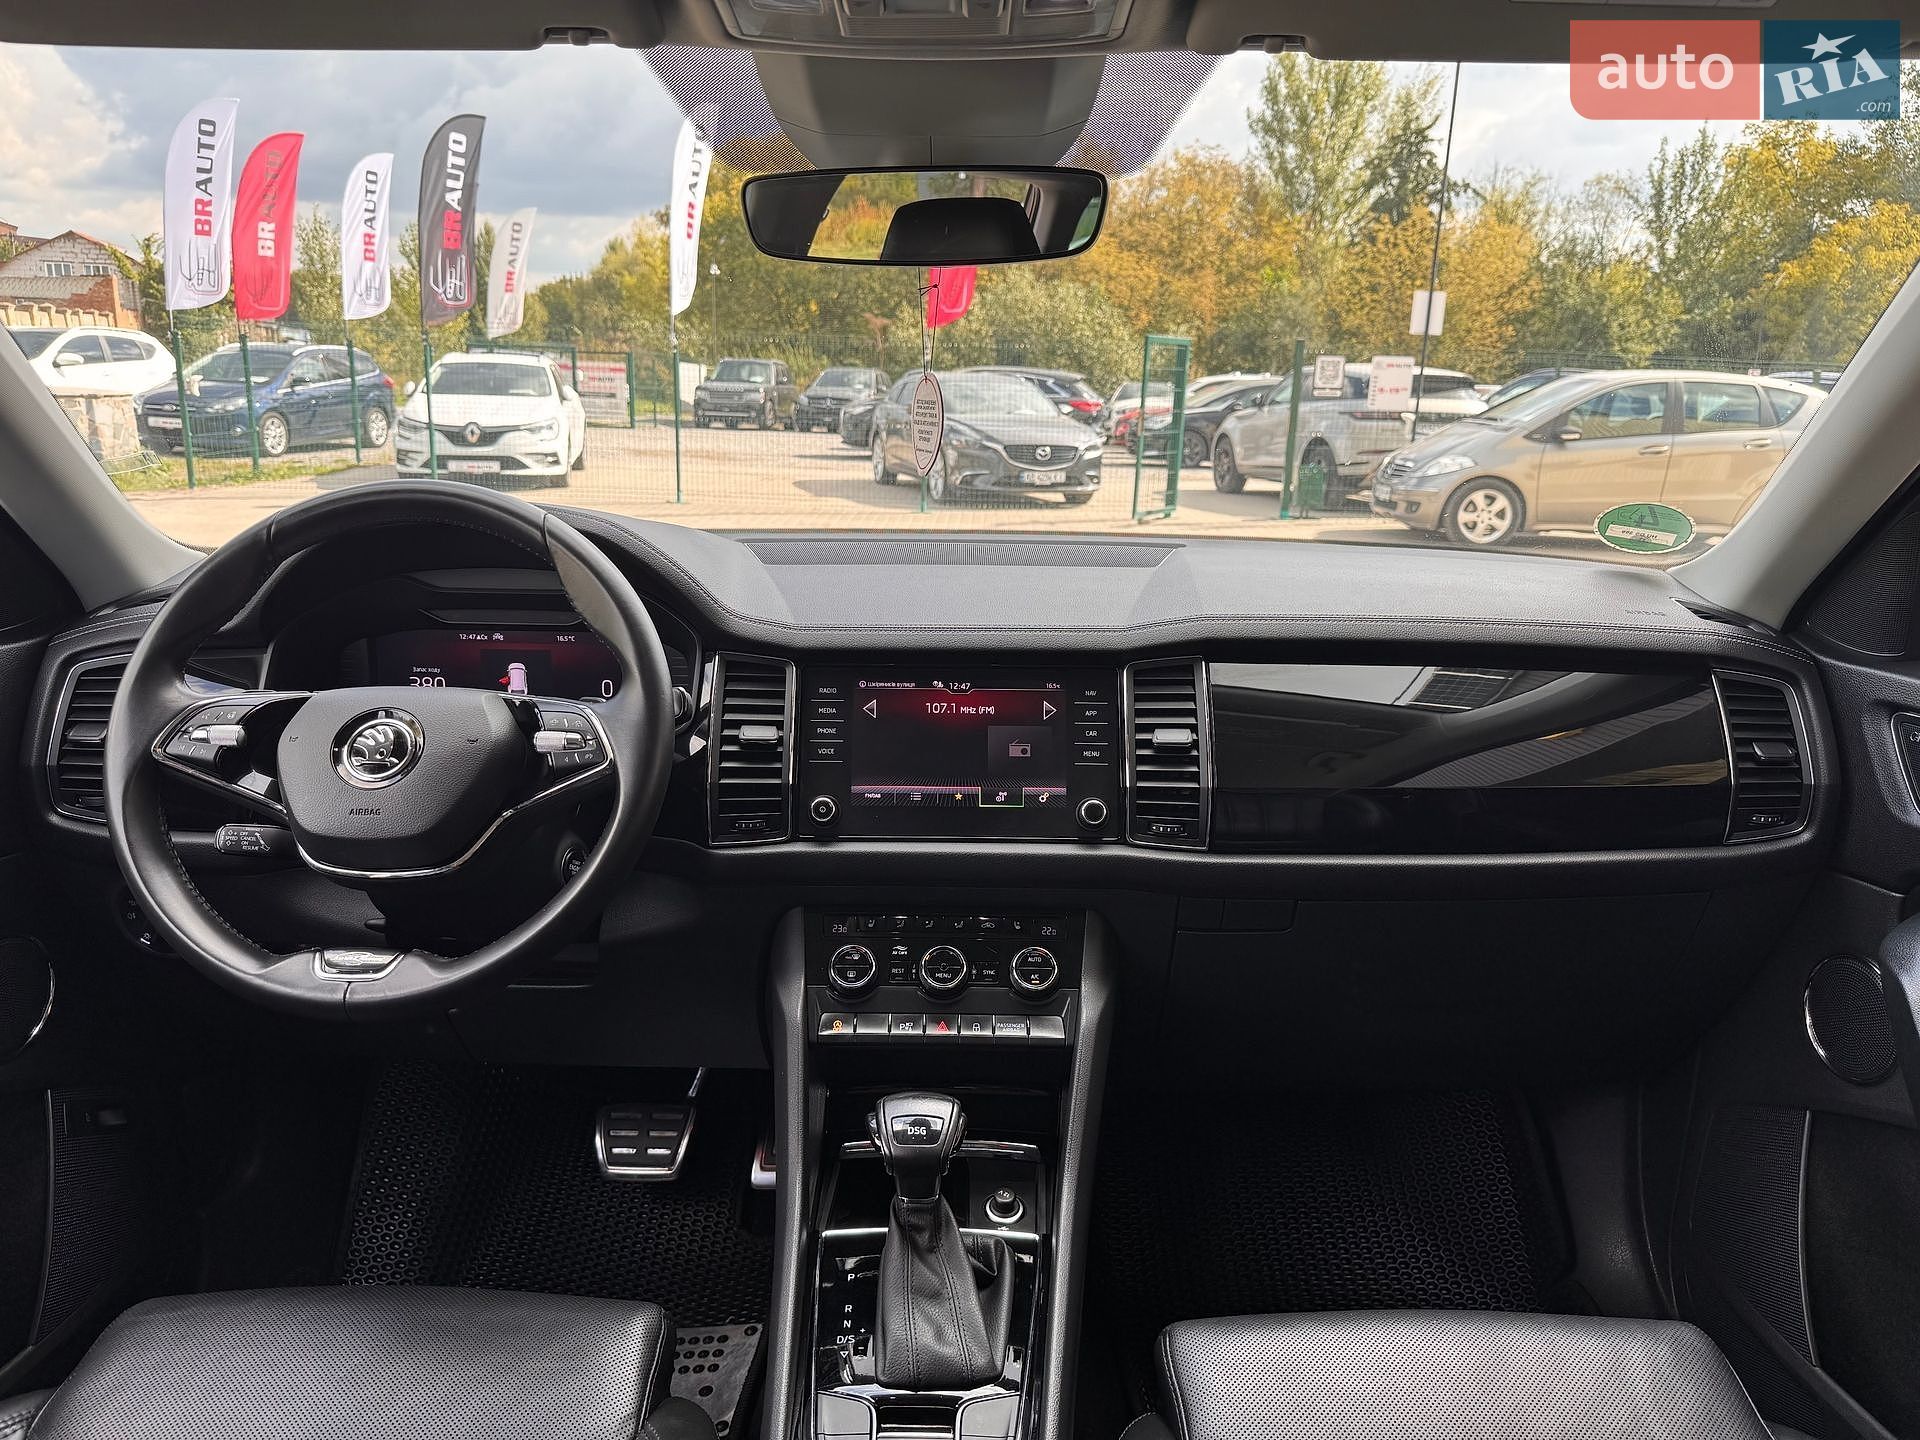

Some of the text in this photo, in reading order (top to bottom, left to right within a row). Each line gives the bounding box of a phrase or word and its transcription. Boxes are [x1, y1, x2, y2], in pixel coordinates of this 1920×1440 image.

[194, 118, 217, 237] BRAUTO
[442, 131, 468, 250] BRAUTO
[363, 170, 379, 263] BRAUTO
[504, 221, 523, 293] BRAUTO
[601, 679, 613, 698] 0
[949, 682, 971, 690] 12:47
[925, 702, 995, 715] 107.1 MHz (FM)
[349, 808, 381, 816] AIRBAG
[907, 1126, 927, 1135] DSG
[847, 1273, 856, 1282] P
[844, 1304, 853, 1313] R
[843, 1319, 852, 1328] N
[836, 1335, 855, 1344] D/S
